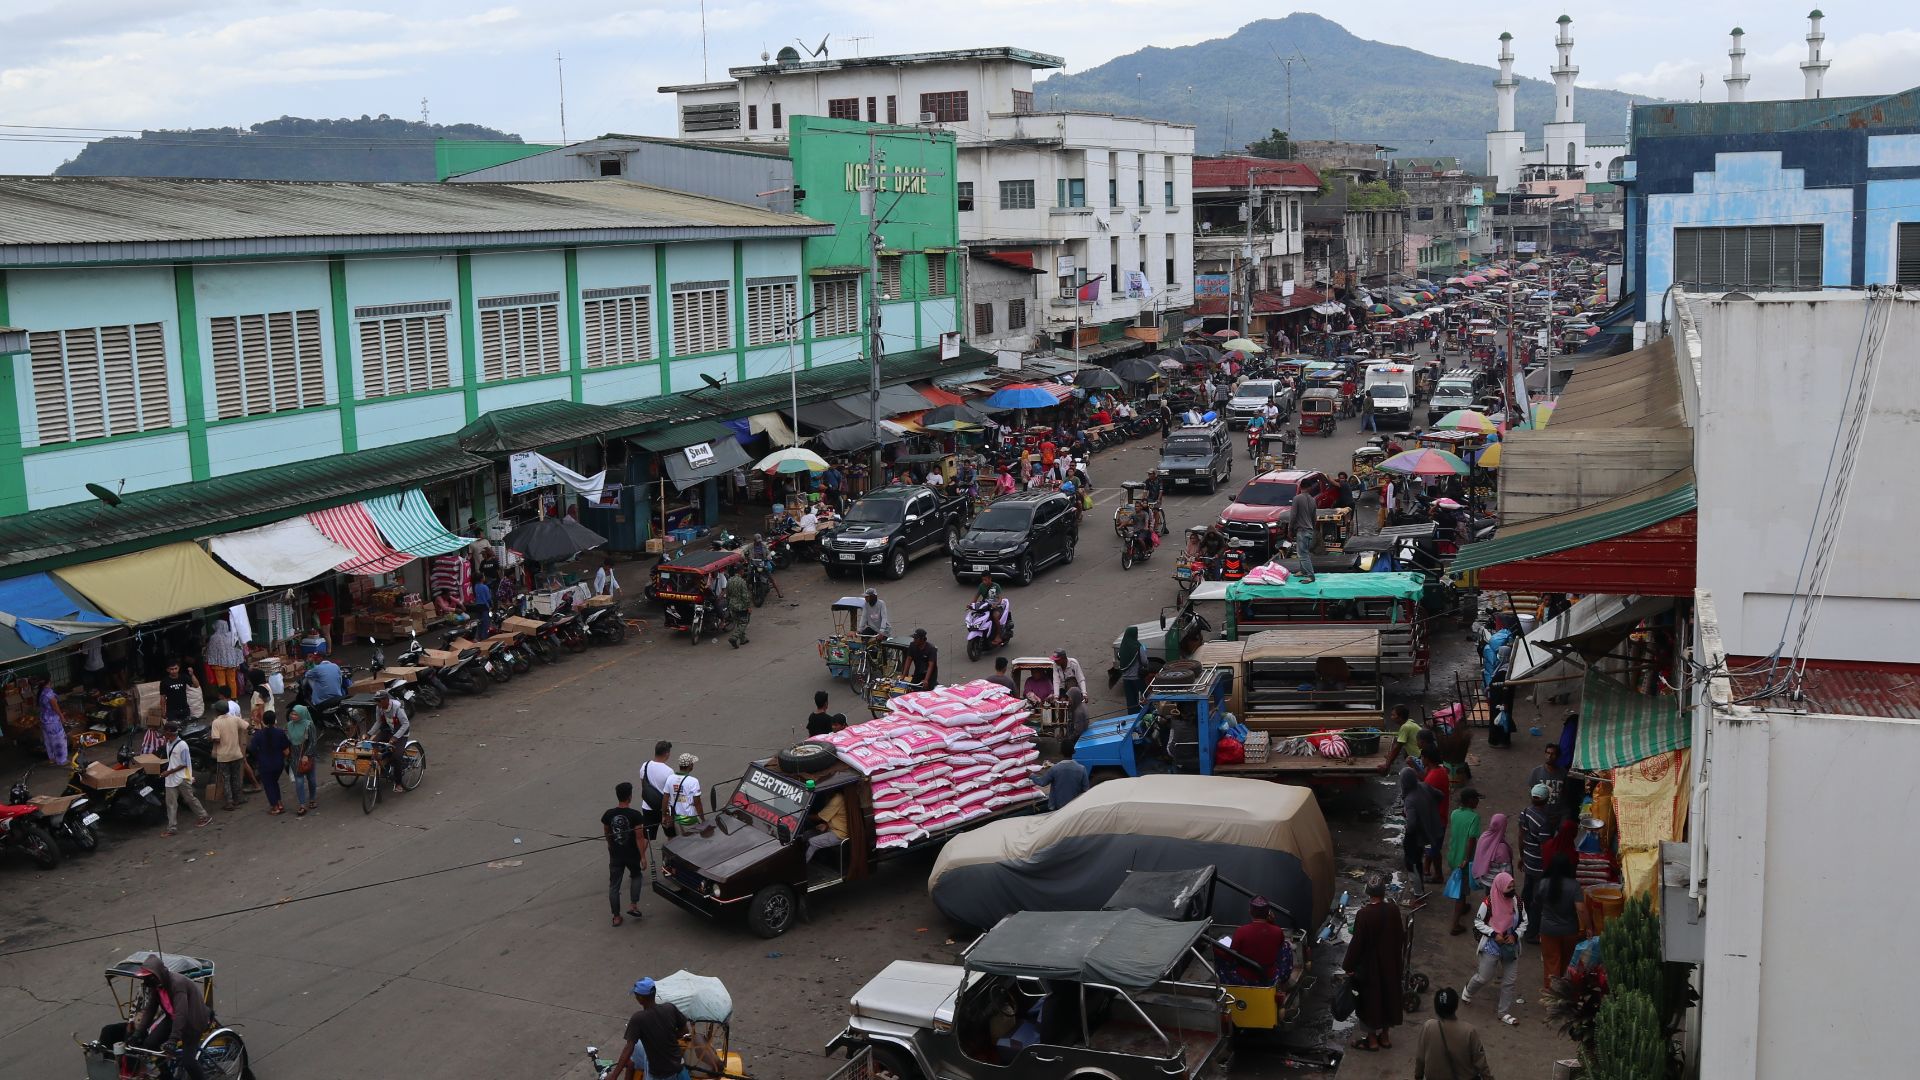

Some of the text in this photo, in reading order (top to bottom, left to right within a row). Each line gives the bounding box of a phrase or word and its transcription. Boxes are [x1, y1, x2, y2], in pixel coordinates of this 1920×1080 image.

[895, 166, 928, 194] DAME
[688, 445, 709, 459] SRM
[751, 770, 804, 804] BERTRINA
